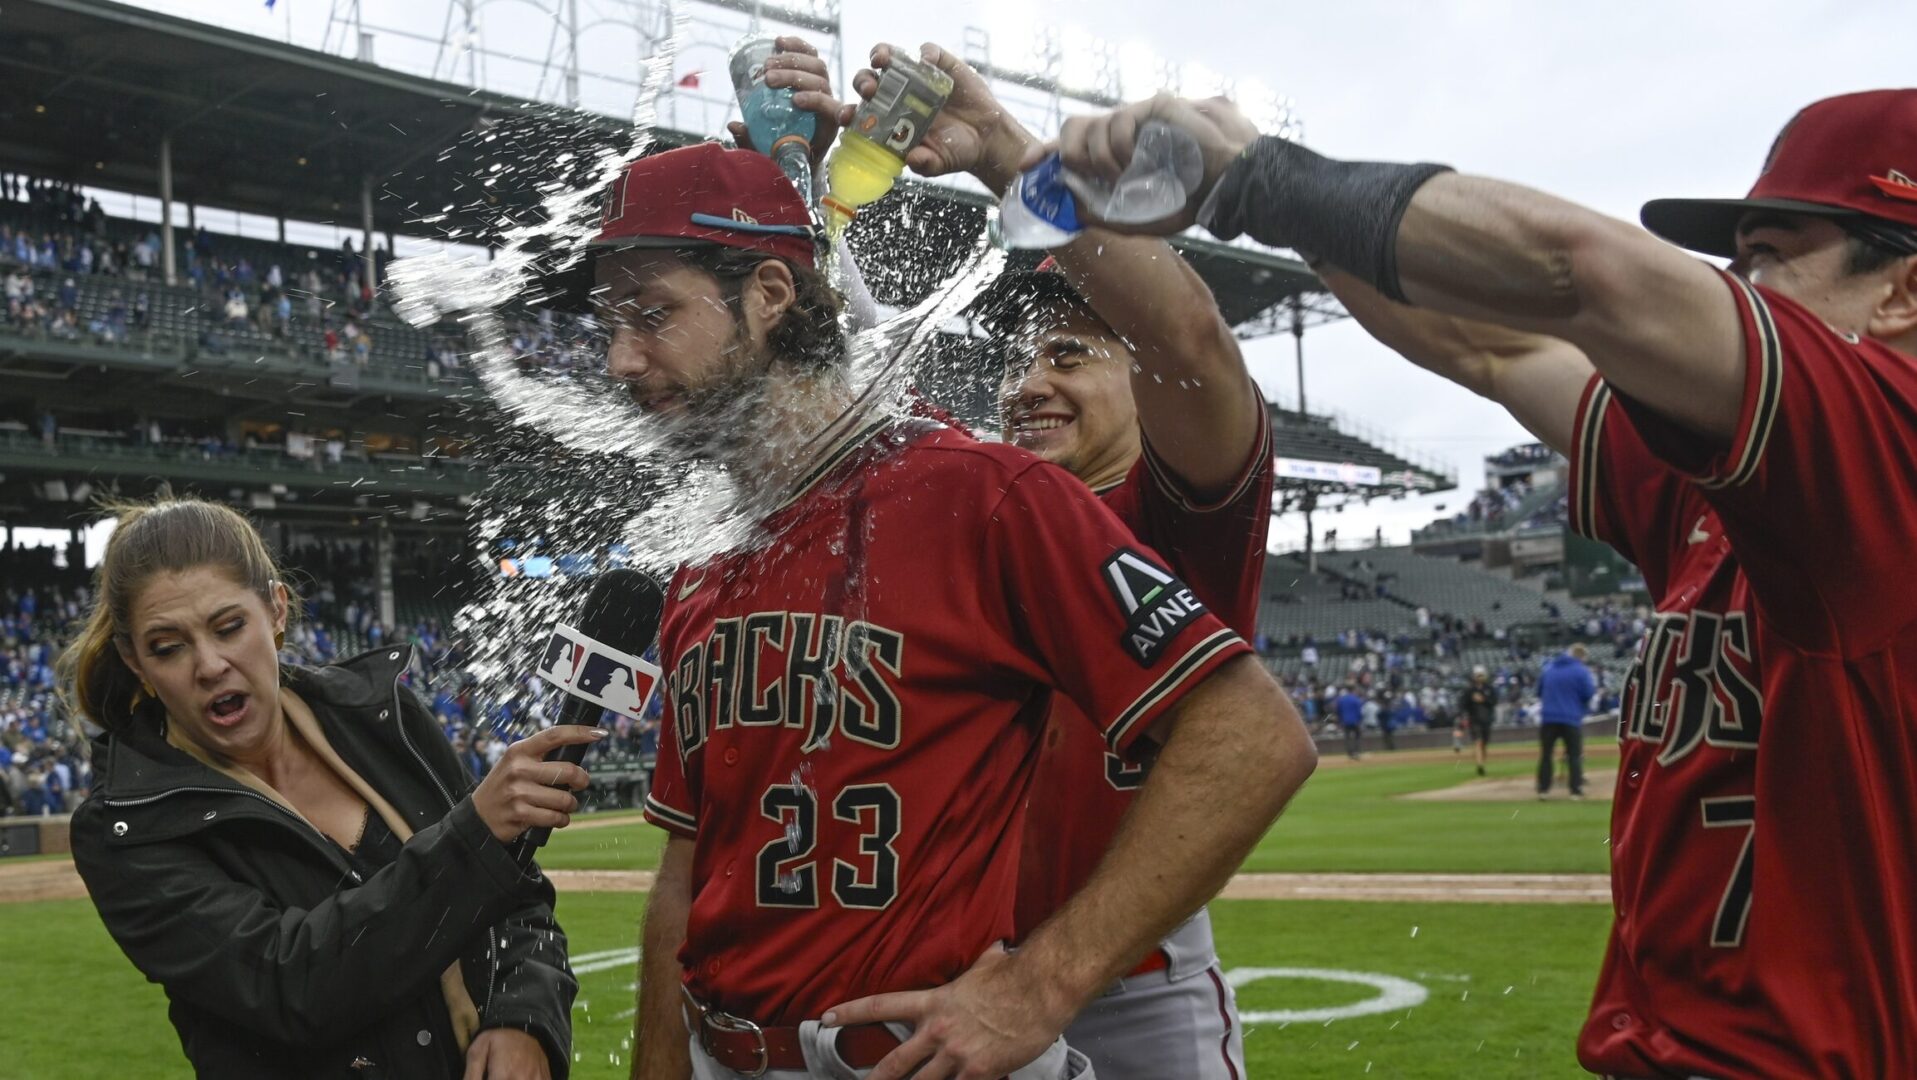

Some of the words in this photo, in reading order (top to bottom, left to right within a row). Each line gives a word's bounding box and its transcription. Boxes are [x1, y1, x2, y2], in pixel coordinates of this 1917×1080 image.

[669, 611, 904, 768] BACKS
[1131, 588, 1202, 659] AVNE
[1617, 609, 1763, 766] ACKS
[756, 783, 901, 911] 23
[1700, 796, 1755, 947] 7
